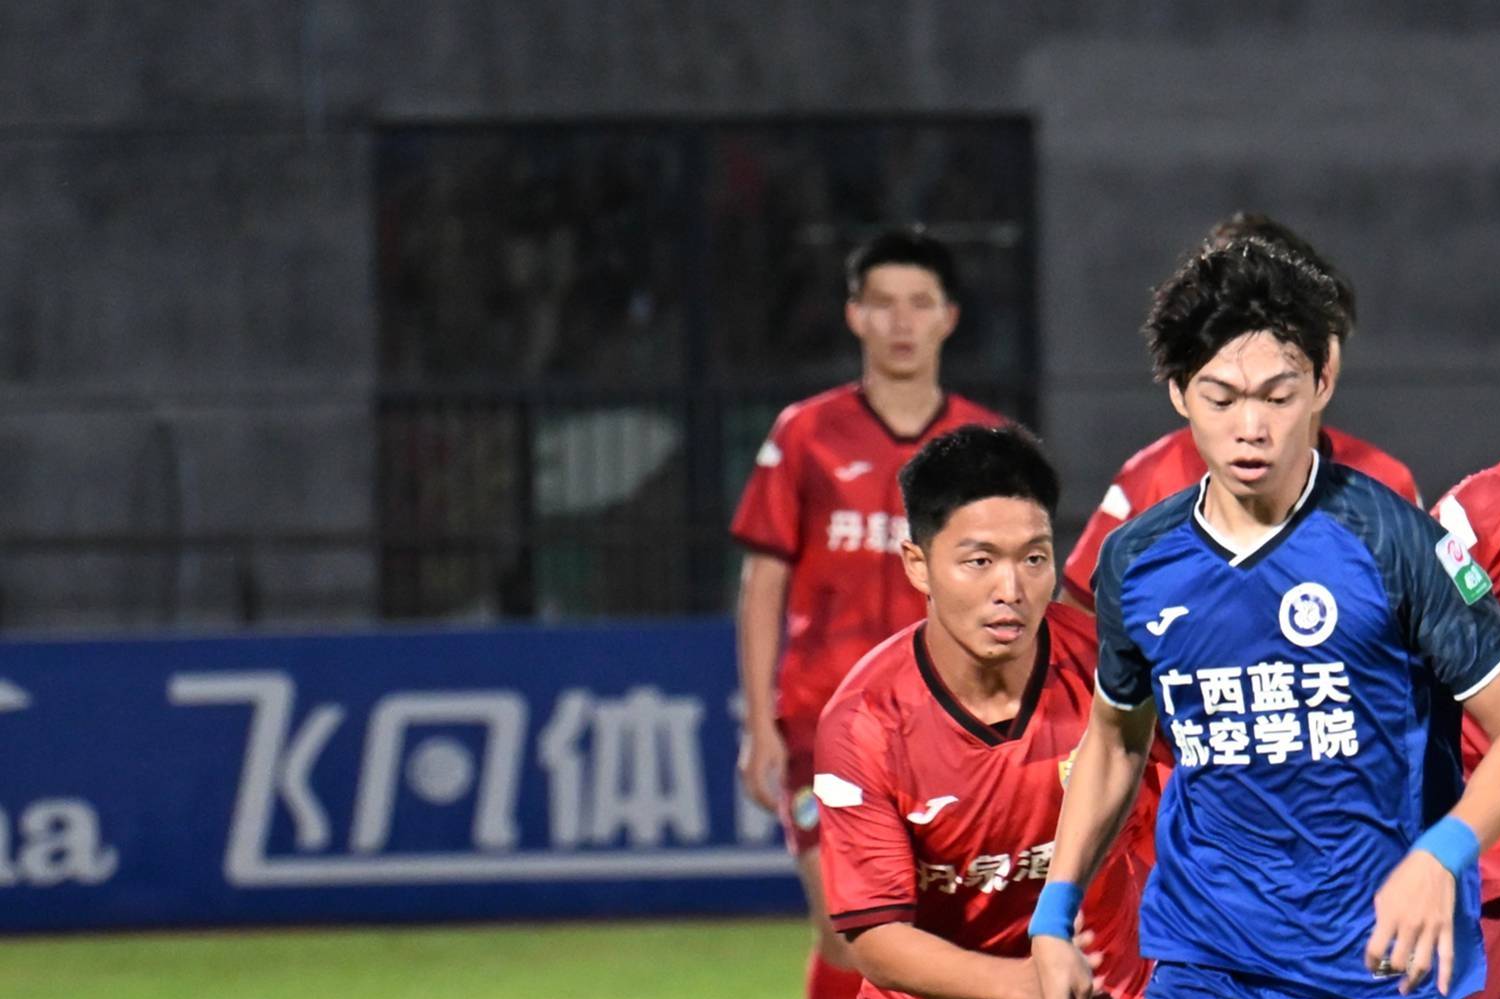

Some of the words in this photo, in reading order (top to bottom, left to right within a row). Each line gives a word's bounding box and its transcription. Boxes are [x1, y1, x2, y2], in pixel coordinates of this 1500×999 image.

[1159, 661, 1352, 716] 广西蓝天
[1170, 708, 1359, 767] 航空学院
